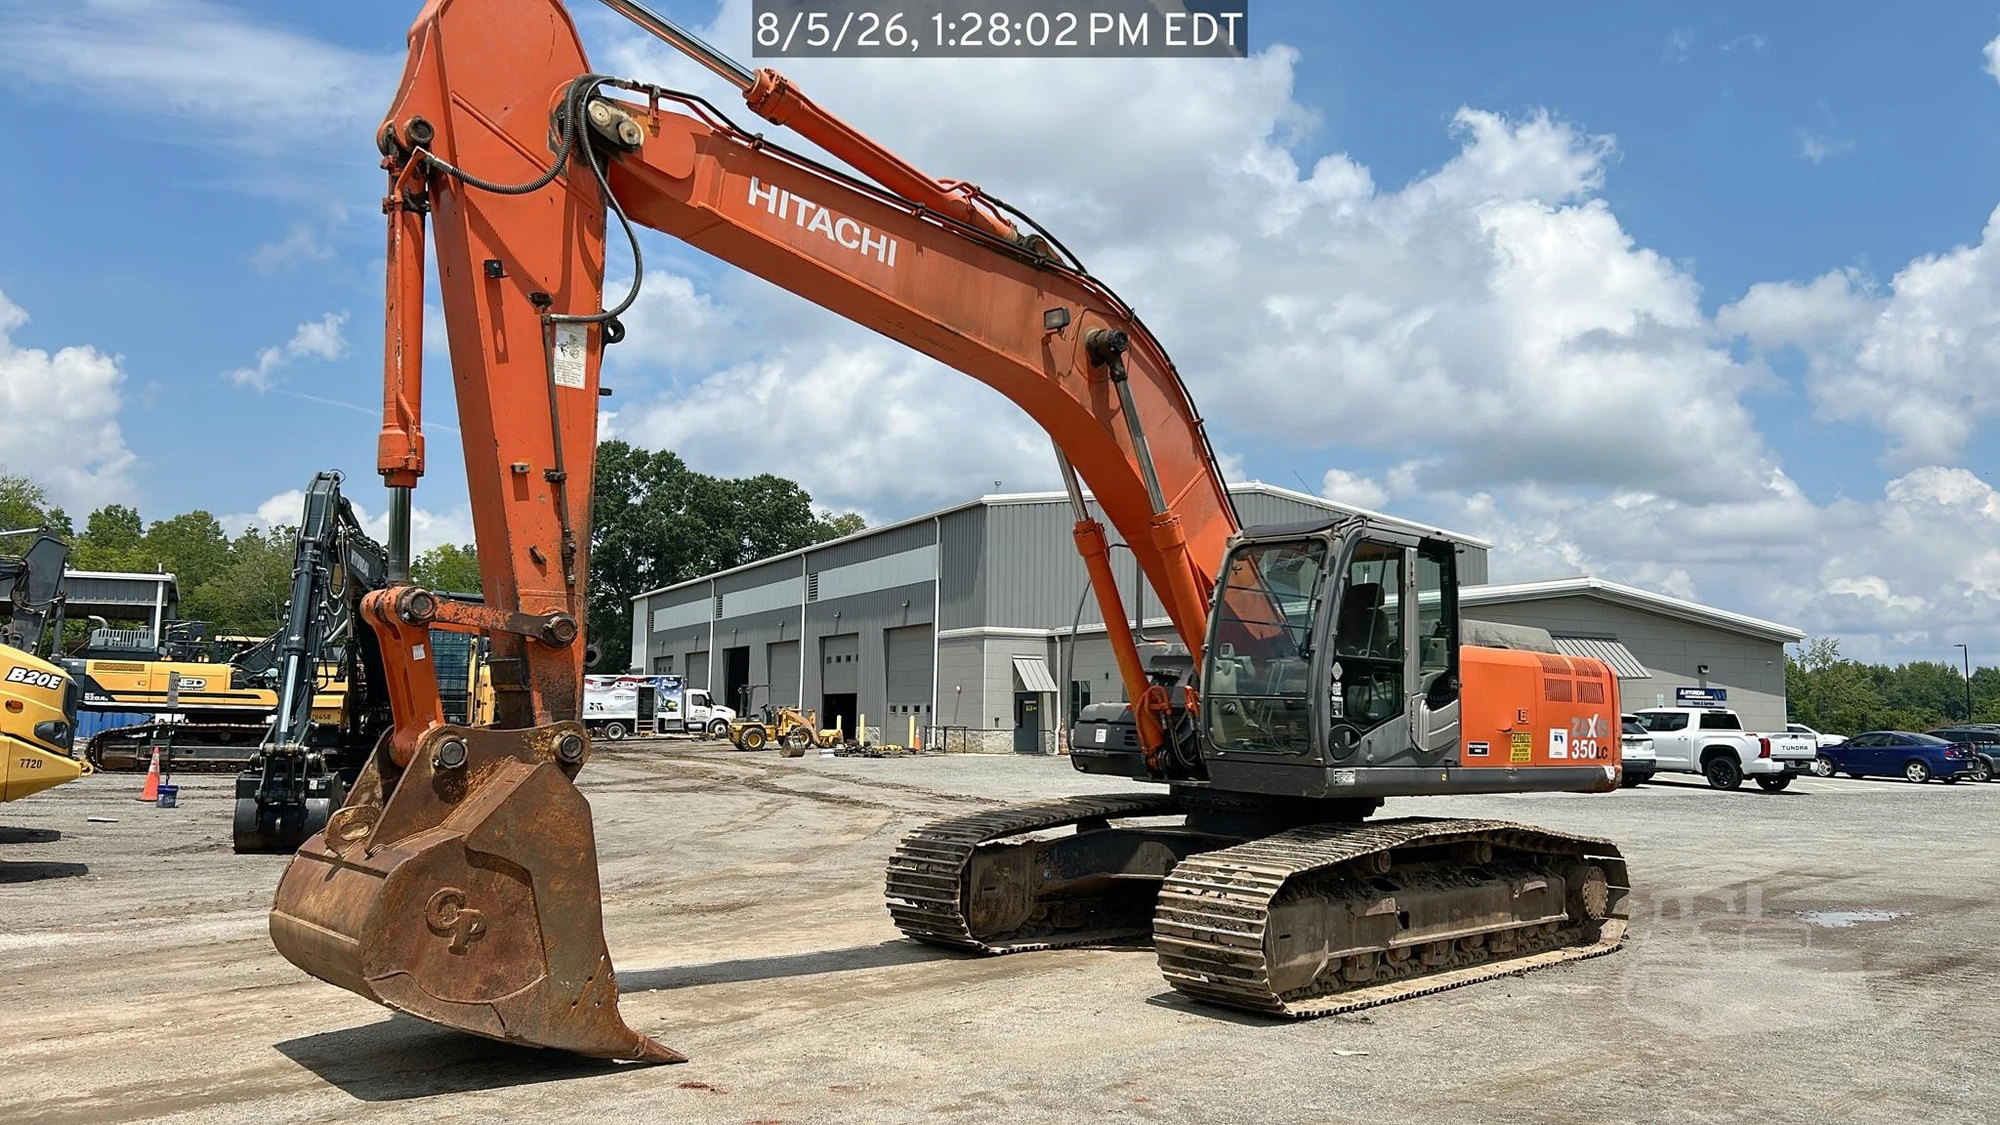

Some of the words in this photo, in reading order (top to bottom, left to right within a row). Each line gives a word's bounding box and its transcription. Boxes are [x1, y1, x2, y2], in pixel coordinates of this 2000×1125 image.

[748, 175, 897, 267] HITACHI
[6, 667, 63, 690] B20E
[1570, 713, 1609, 738] ZAXIS
[20, 758, 43, 769] 7720
